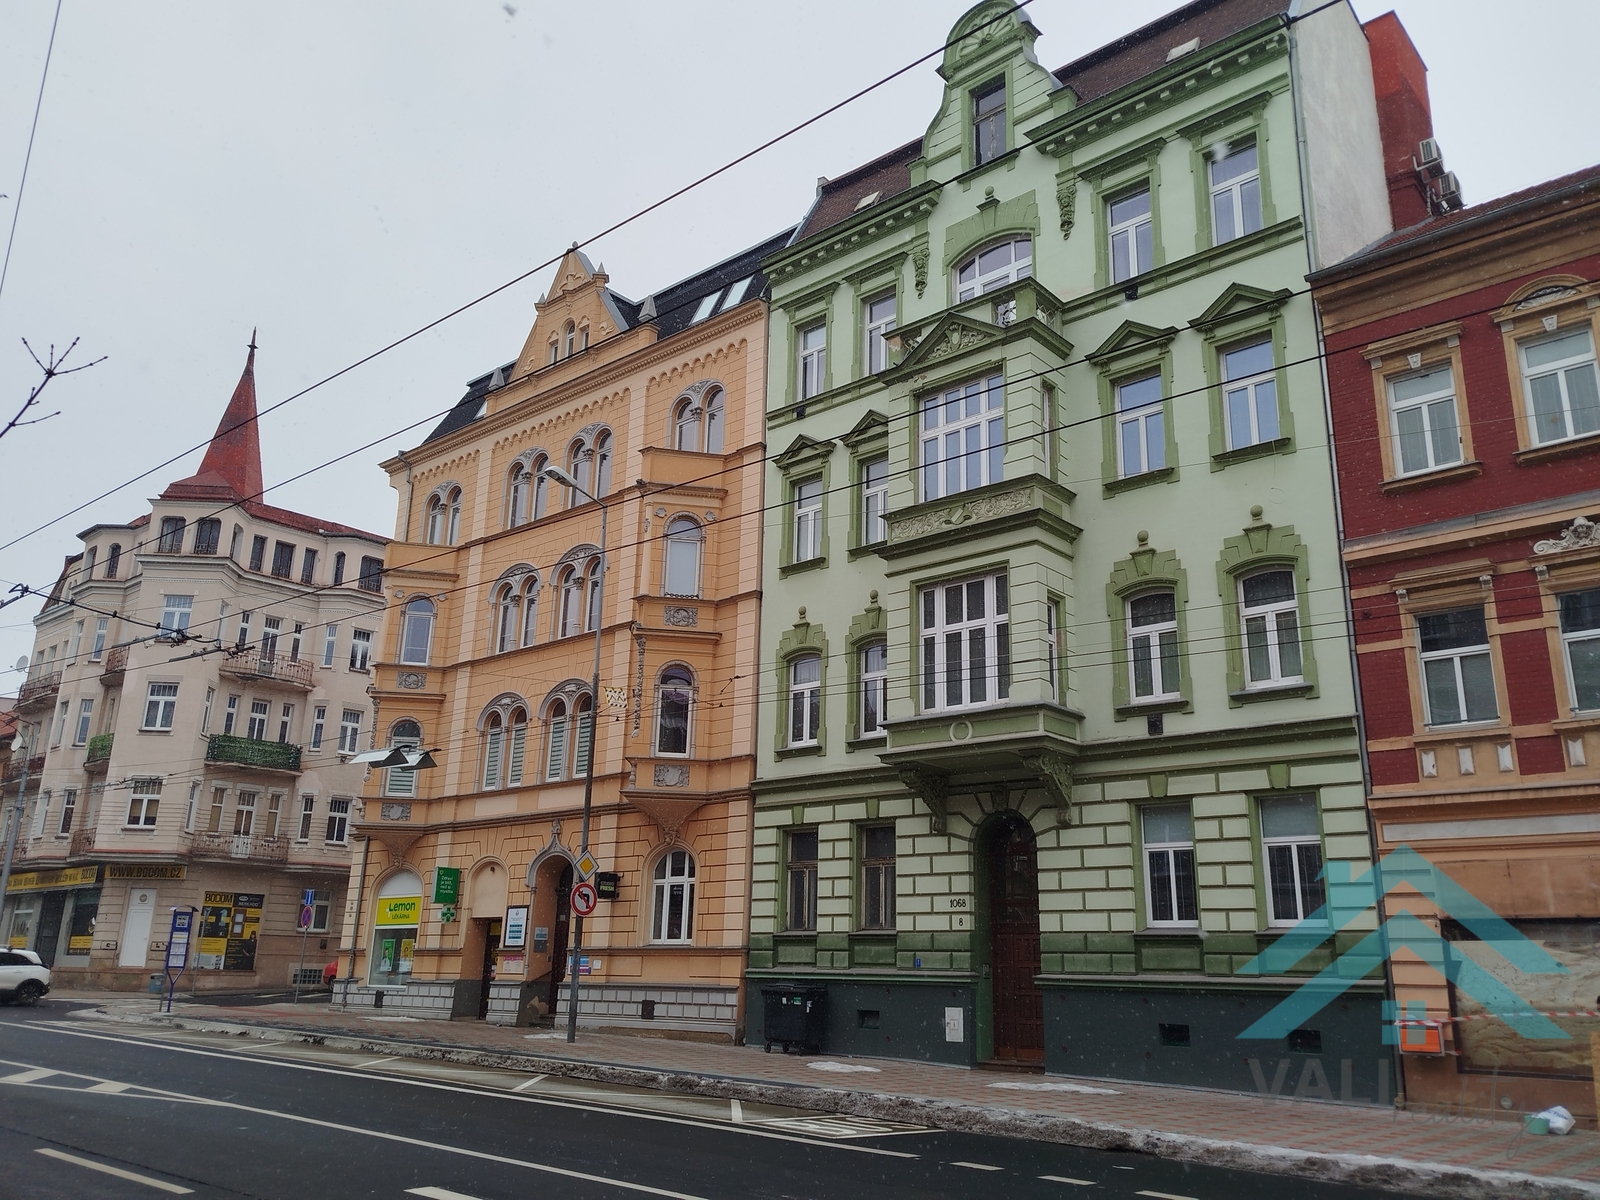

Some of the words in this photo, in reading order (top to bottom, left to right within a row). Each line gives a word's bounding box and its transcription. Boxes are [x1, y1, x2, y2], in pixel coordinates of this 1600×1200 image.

[205, 893, 233, 904] BODOM
[949, 898, 967, 908] 1068
[388, 902, 416, 911] Lemon
[391, 912, 411, 920] LÉKÁRNA
[958, 917, 963, 926] 8
